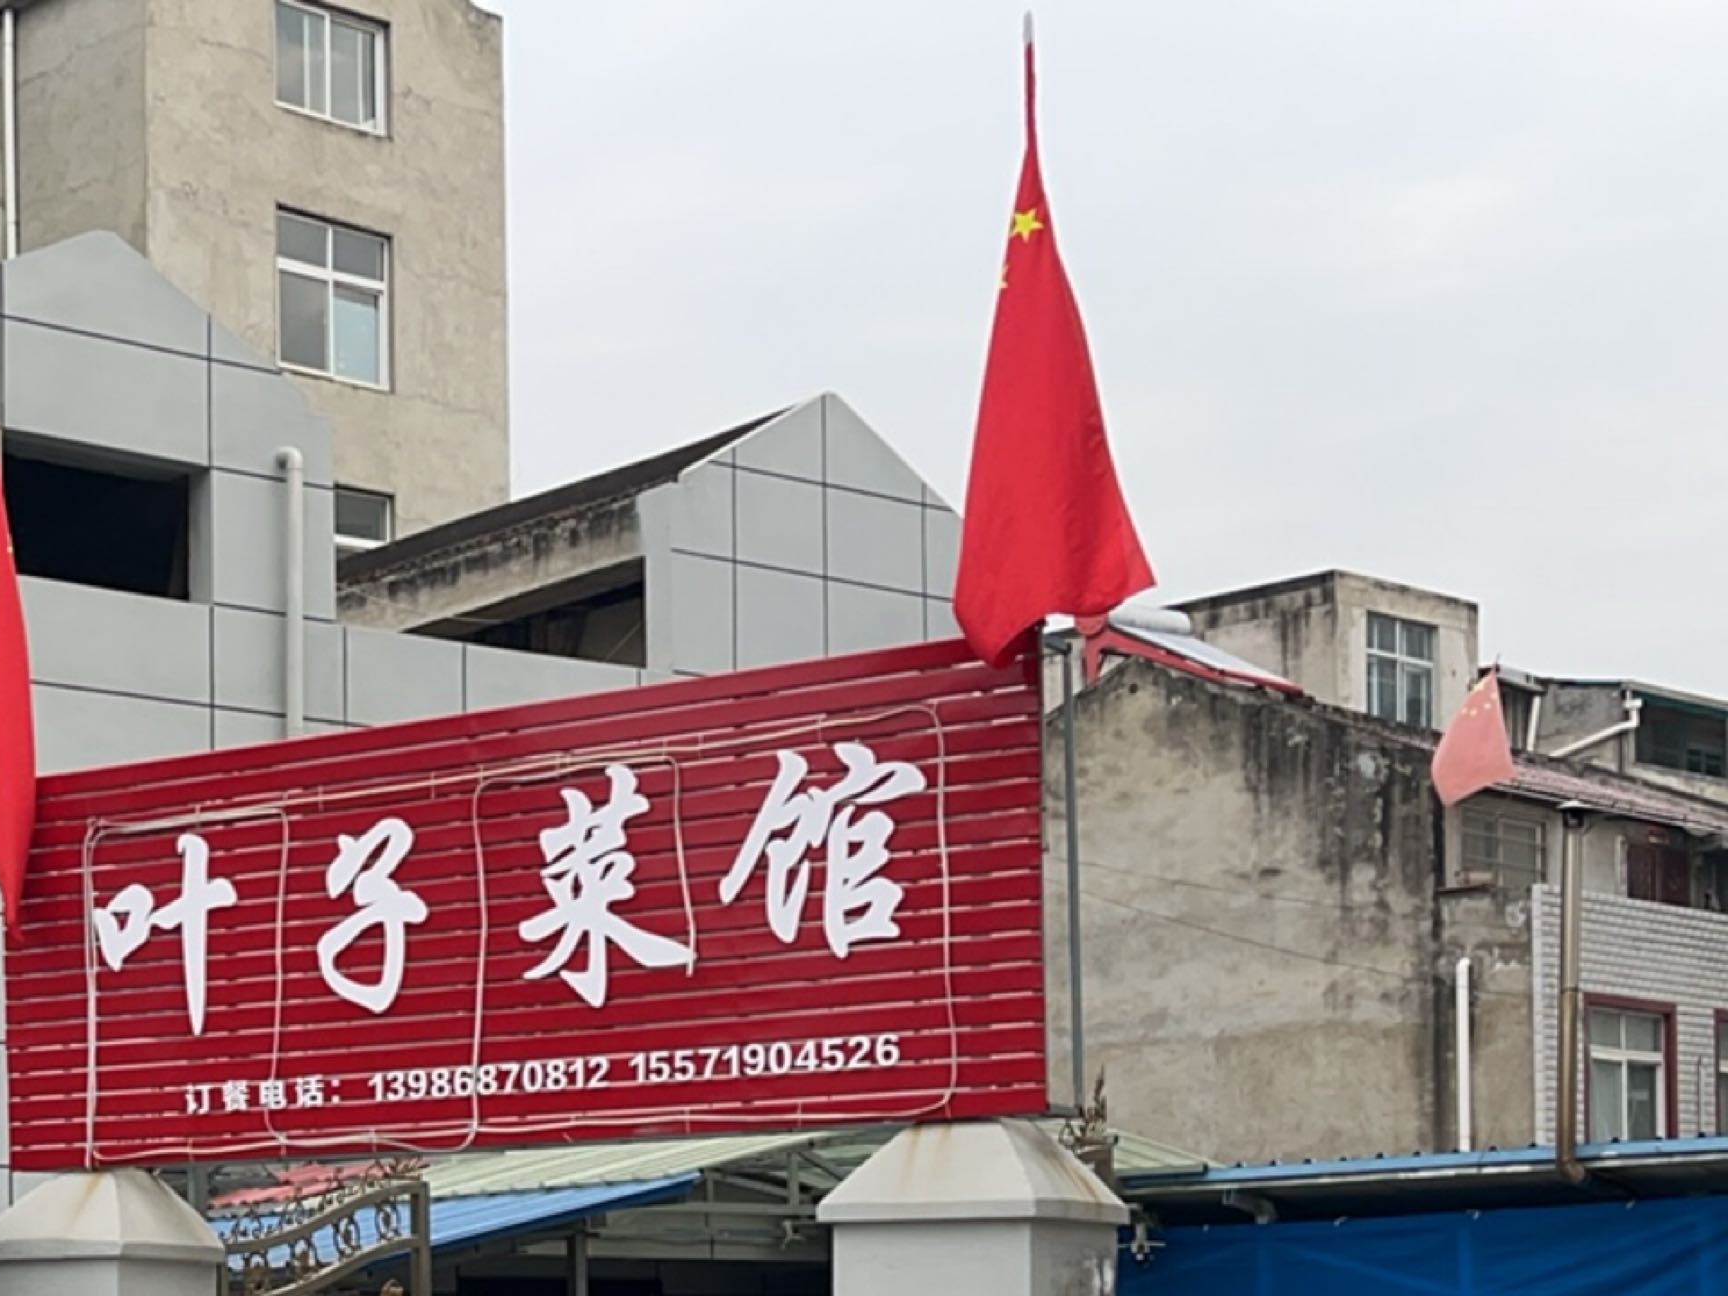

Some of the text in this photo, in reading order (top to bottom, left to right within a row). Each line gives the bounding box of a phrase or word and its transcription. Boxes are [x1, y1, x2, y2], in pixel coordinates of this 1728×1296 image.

[94, 743, 928, 1036] 叶子菜馆
[368, 1056, 610, 1102] 13986870812
[629, 1034, 900, 1083] 15571904526
